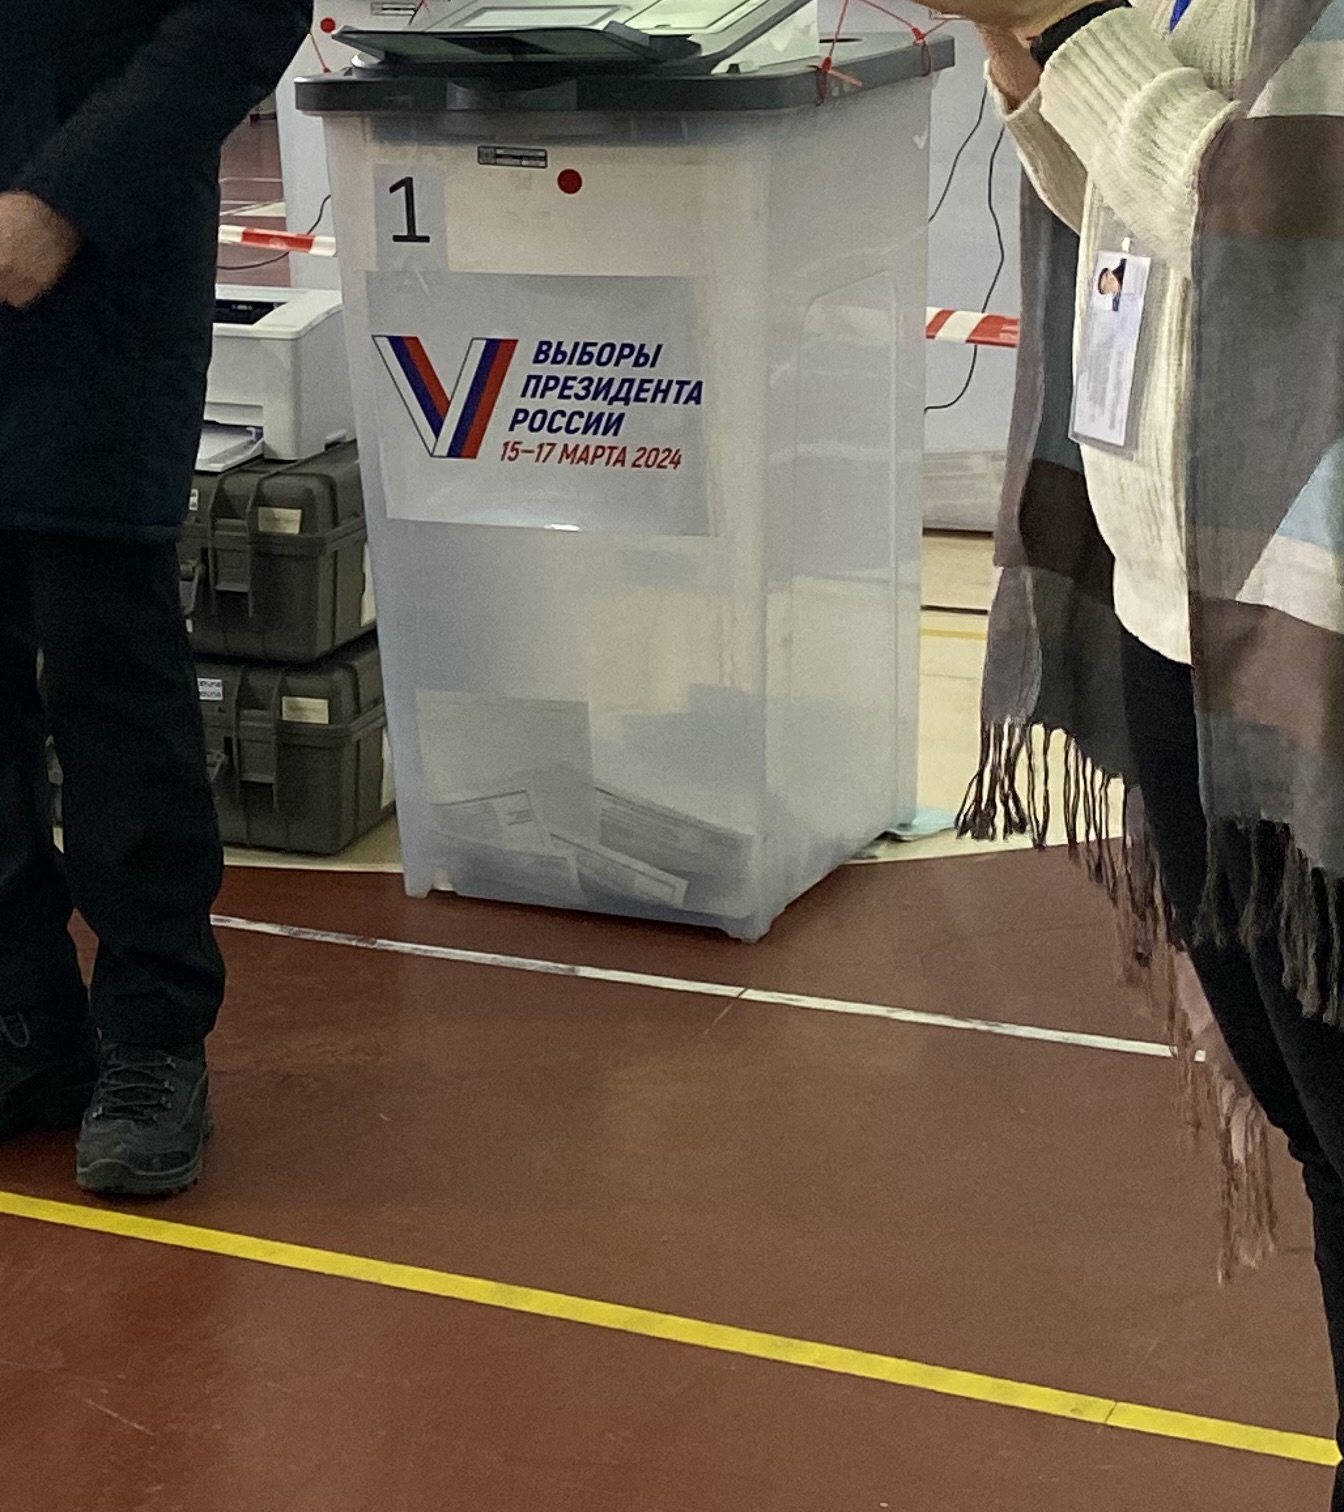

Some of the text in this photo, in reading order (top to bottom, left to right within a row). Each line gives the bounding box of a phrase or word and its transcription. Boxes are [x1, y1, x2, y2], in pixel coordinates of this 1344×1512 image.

[388, 176, 431, 244] 1
[532, 340, 664, 368] ВЫБОРЫ
[520, 374, 704, 406] ПРЕЗИДЕНТА
[508, 408, 626, 437] РОССИИ
[558, 442, 628, 468] МАРТА
[631, 446, 683, 470] 2024
